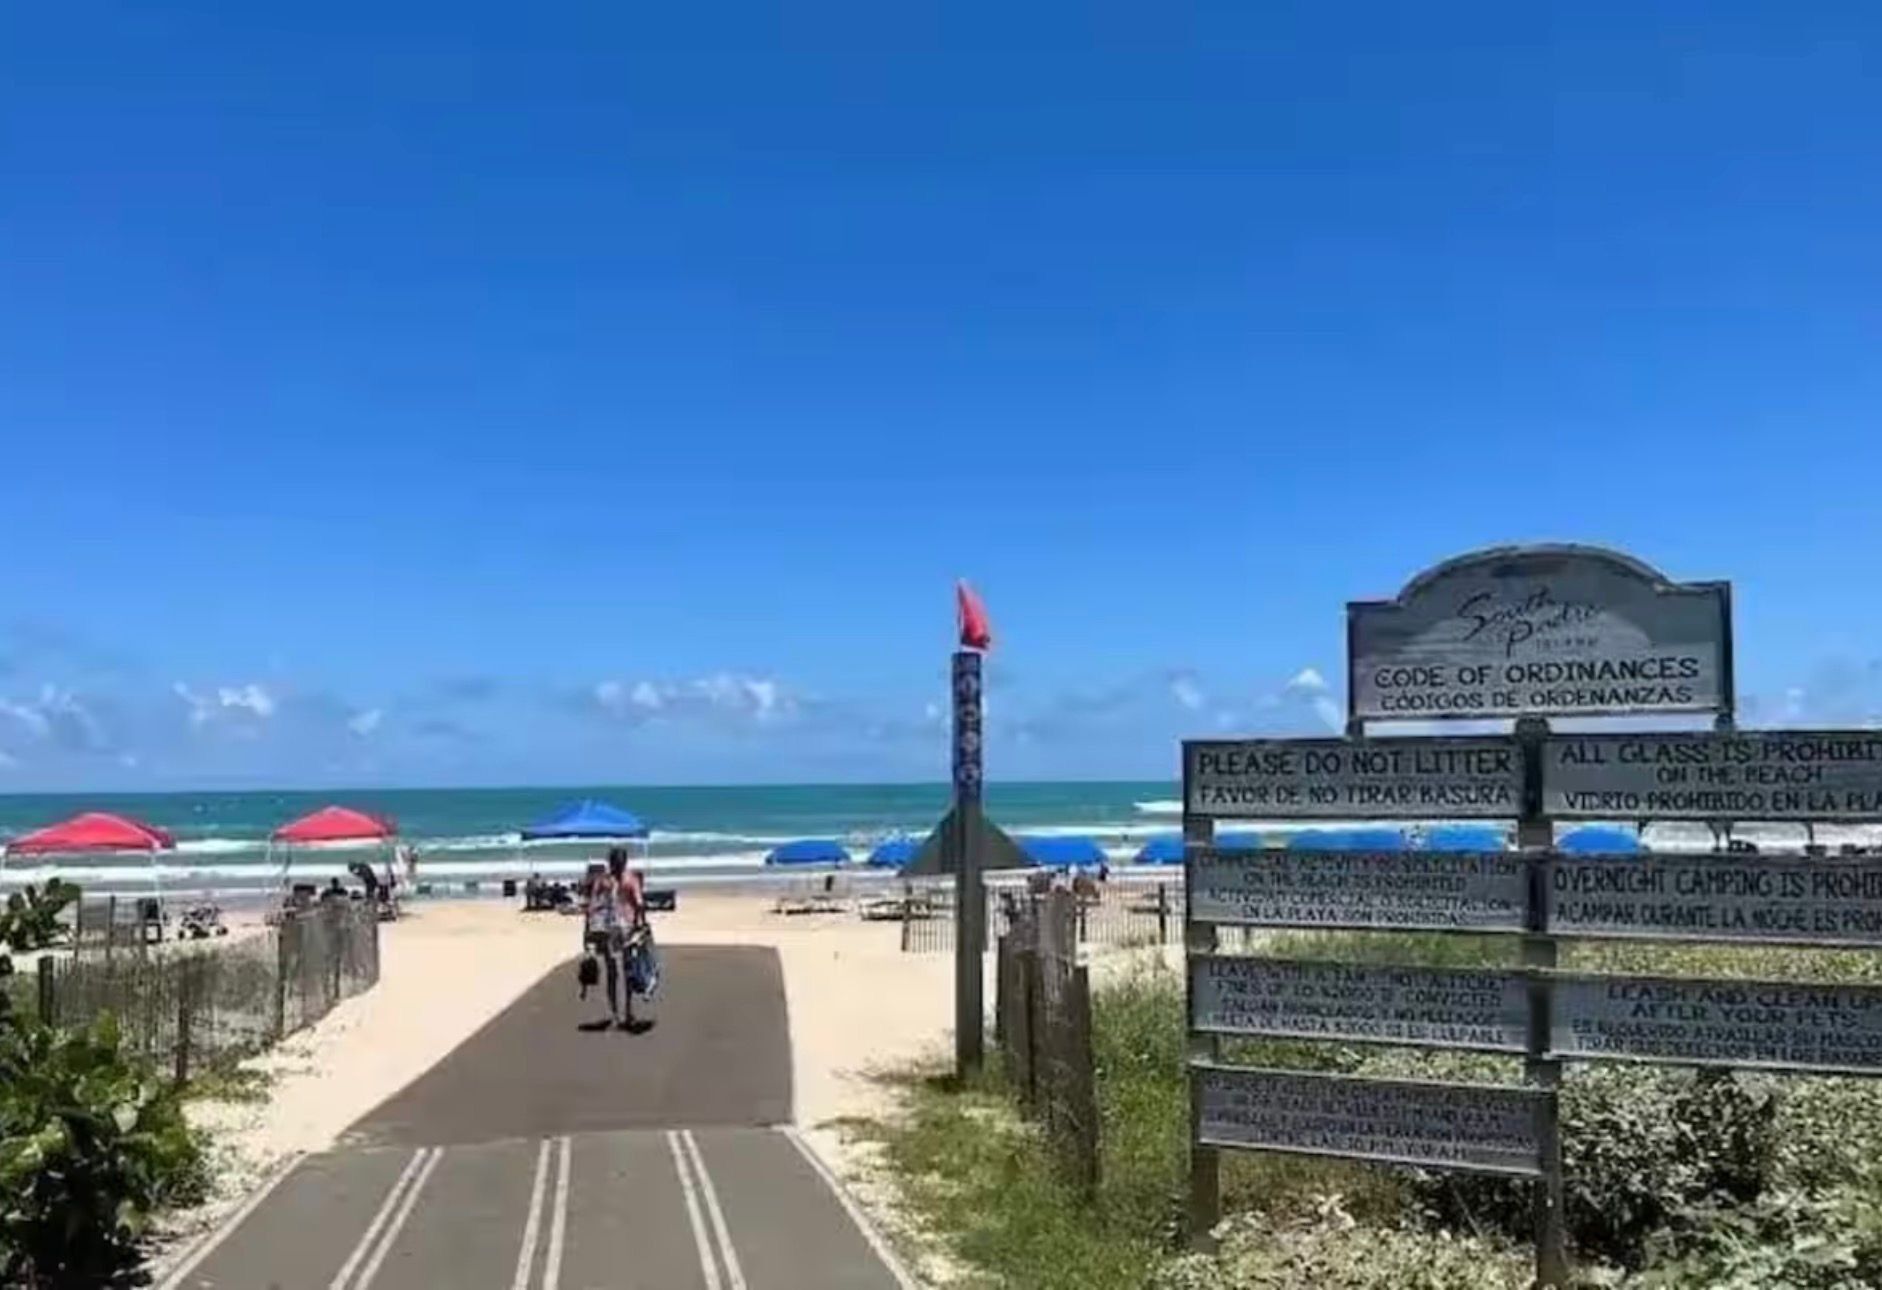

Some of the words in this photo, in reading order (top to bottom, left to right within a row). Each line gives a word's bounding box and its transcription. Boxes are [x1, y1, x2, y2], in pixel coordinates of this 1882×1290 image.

[1456, 586, 1556, 642] South
[1505, 600, 1605, 659] Padre
[1374, 665, 1446, 689] CODE
[1457, 664, 1493, 686] OF
[1504, 656, 1699, 685] ORDINANCES
[1491, 690, 1521, 709] DE
[1529, 685, 1694, 706] ORDENANZAS
[1199, 750, 1297, 775] PLEASE
[1304, 750, 1341, 775] DO
[1352, 750, 1402, 774] NOT
[1414, 748, 1512, 774] LITTER
[1558, 741, 1607, 764] ALL
[1618, 742, 1710, 764] GLASS
[1721, 741, 1752, 764] IS
[1762, 740, 1882, 763] PROHIBI
[1656, 766, 1687, 784] ON
[1698, 766, 1736, 785] THE
[1744, 765, 1823, 785] BEACH
[1200, 785, 1269, 805] FAVOR
[1275, 785, 1301, 806] DE
[1309, 785, 1339, 805] NO
[1346, 785, 1411, 805] TIRAR
[1419, 784, 1511, 806] BASURA
[1564, 789, 1640, 811] VIDRIO
[1647, 791, 1763, 811] PROHIBIDO
[1771, 791, 1800, 812] EN
[1806, 791, 1837, 812] LA
[1554, 866, 1666, 893] OVERNIGHT
[1675, 868, 1773, 897] CAMPING
[1779, 871, 1806, 898] IS
[1556, 902, 1635, 925] ACAMPAR
[1641, 904, 1717, 929] DURANTE
[1721, 906, 1747, 930] LA
[1813, 909, 1838, 932] ES
[1606, 983, 1687, 1002] LEASH
[1698, 986, 1748, 1006] AND
[1756, 989, 1839, 1009] CLEAN
[1629, 1002, 1712, 1021] AFTER
[1720, 1007, 1786, 1025] YOUR
[1796, 1009, 1859, 1028] PETS
